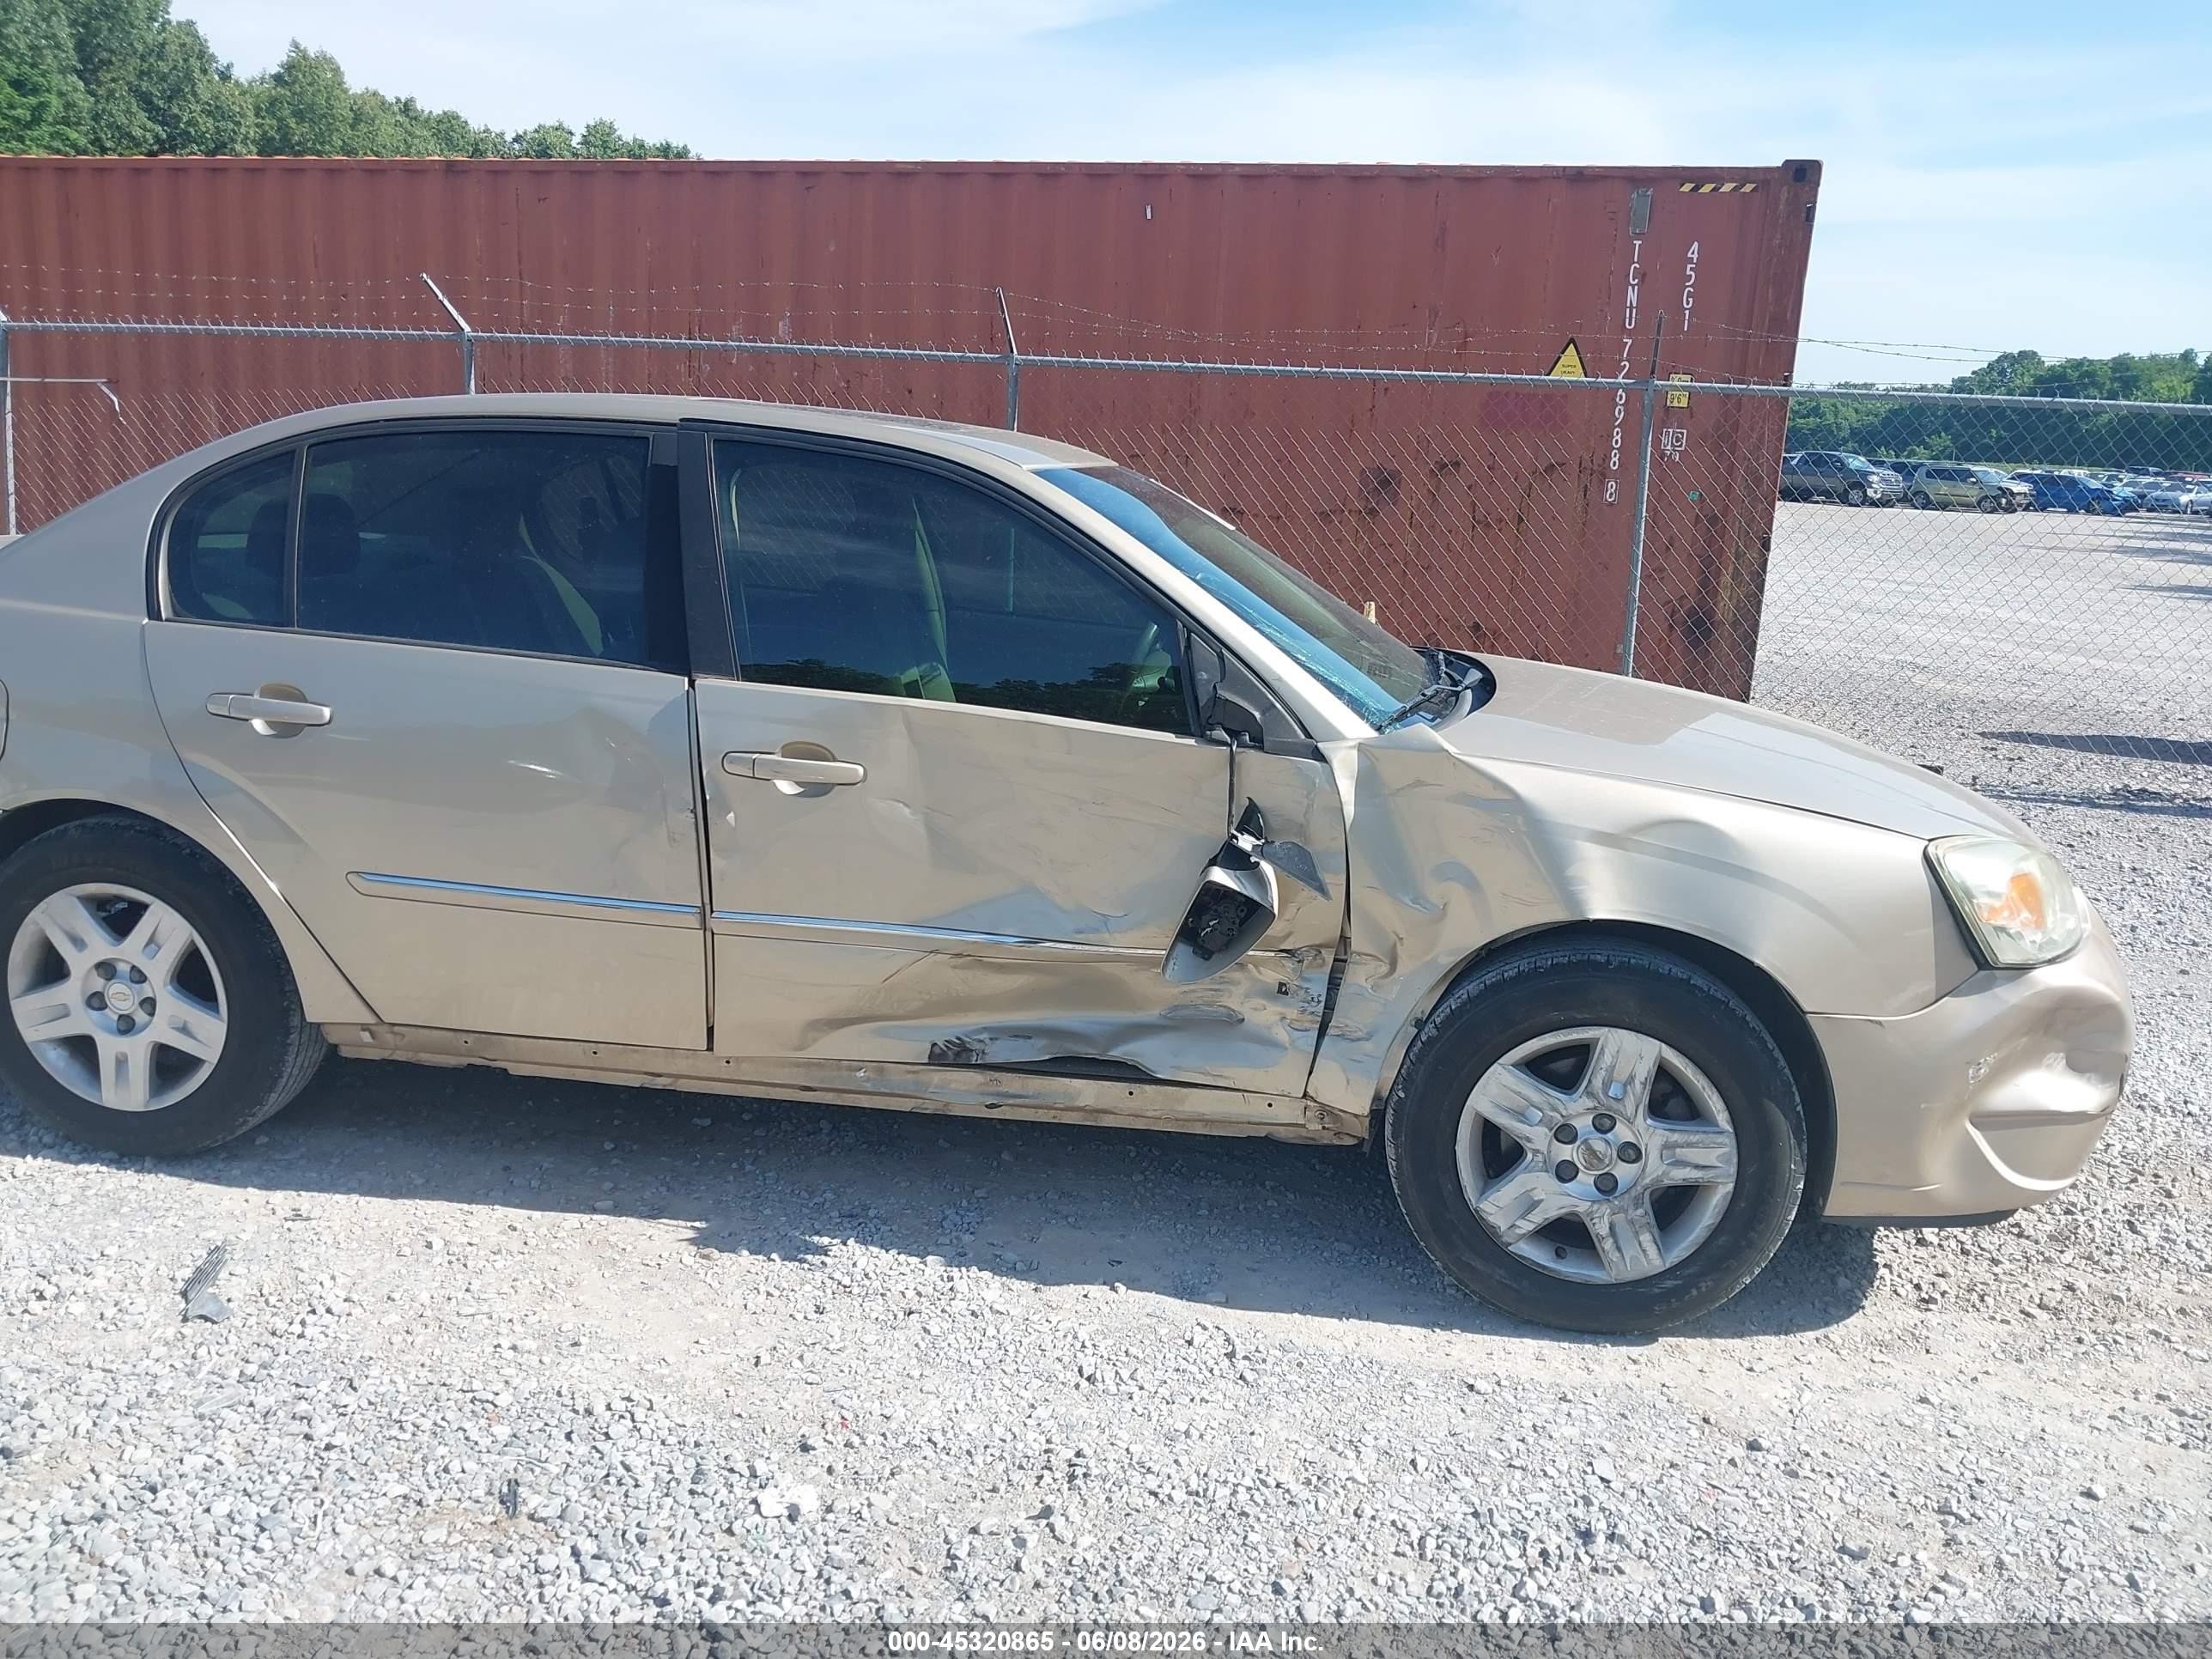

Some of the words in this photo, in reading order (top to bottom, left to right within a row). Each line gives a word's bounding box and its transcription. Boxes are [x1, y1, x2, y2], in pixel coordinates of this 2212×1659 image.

[1625, 240, 1643, 330] TCNU
[1682, 240, 1699, 331] 45G1
[1609, 338, 1633, 471] 726988
[1605, 480, 1617, 502] 8
